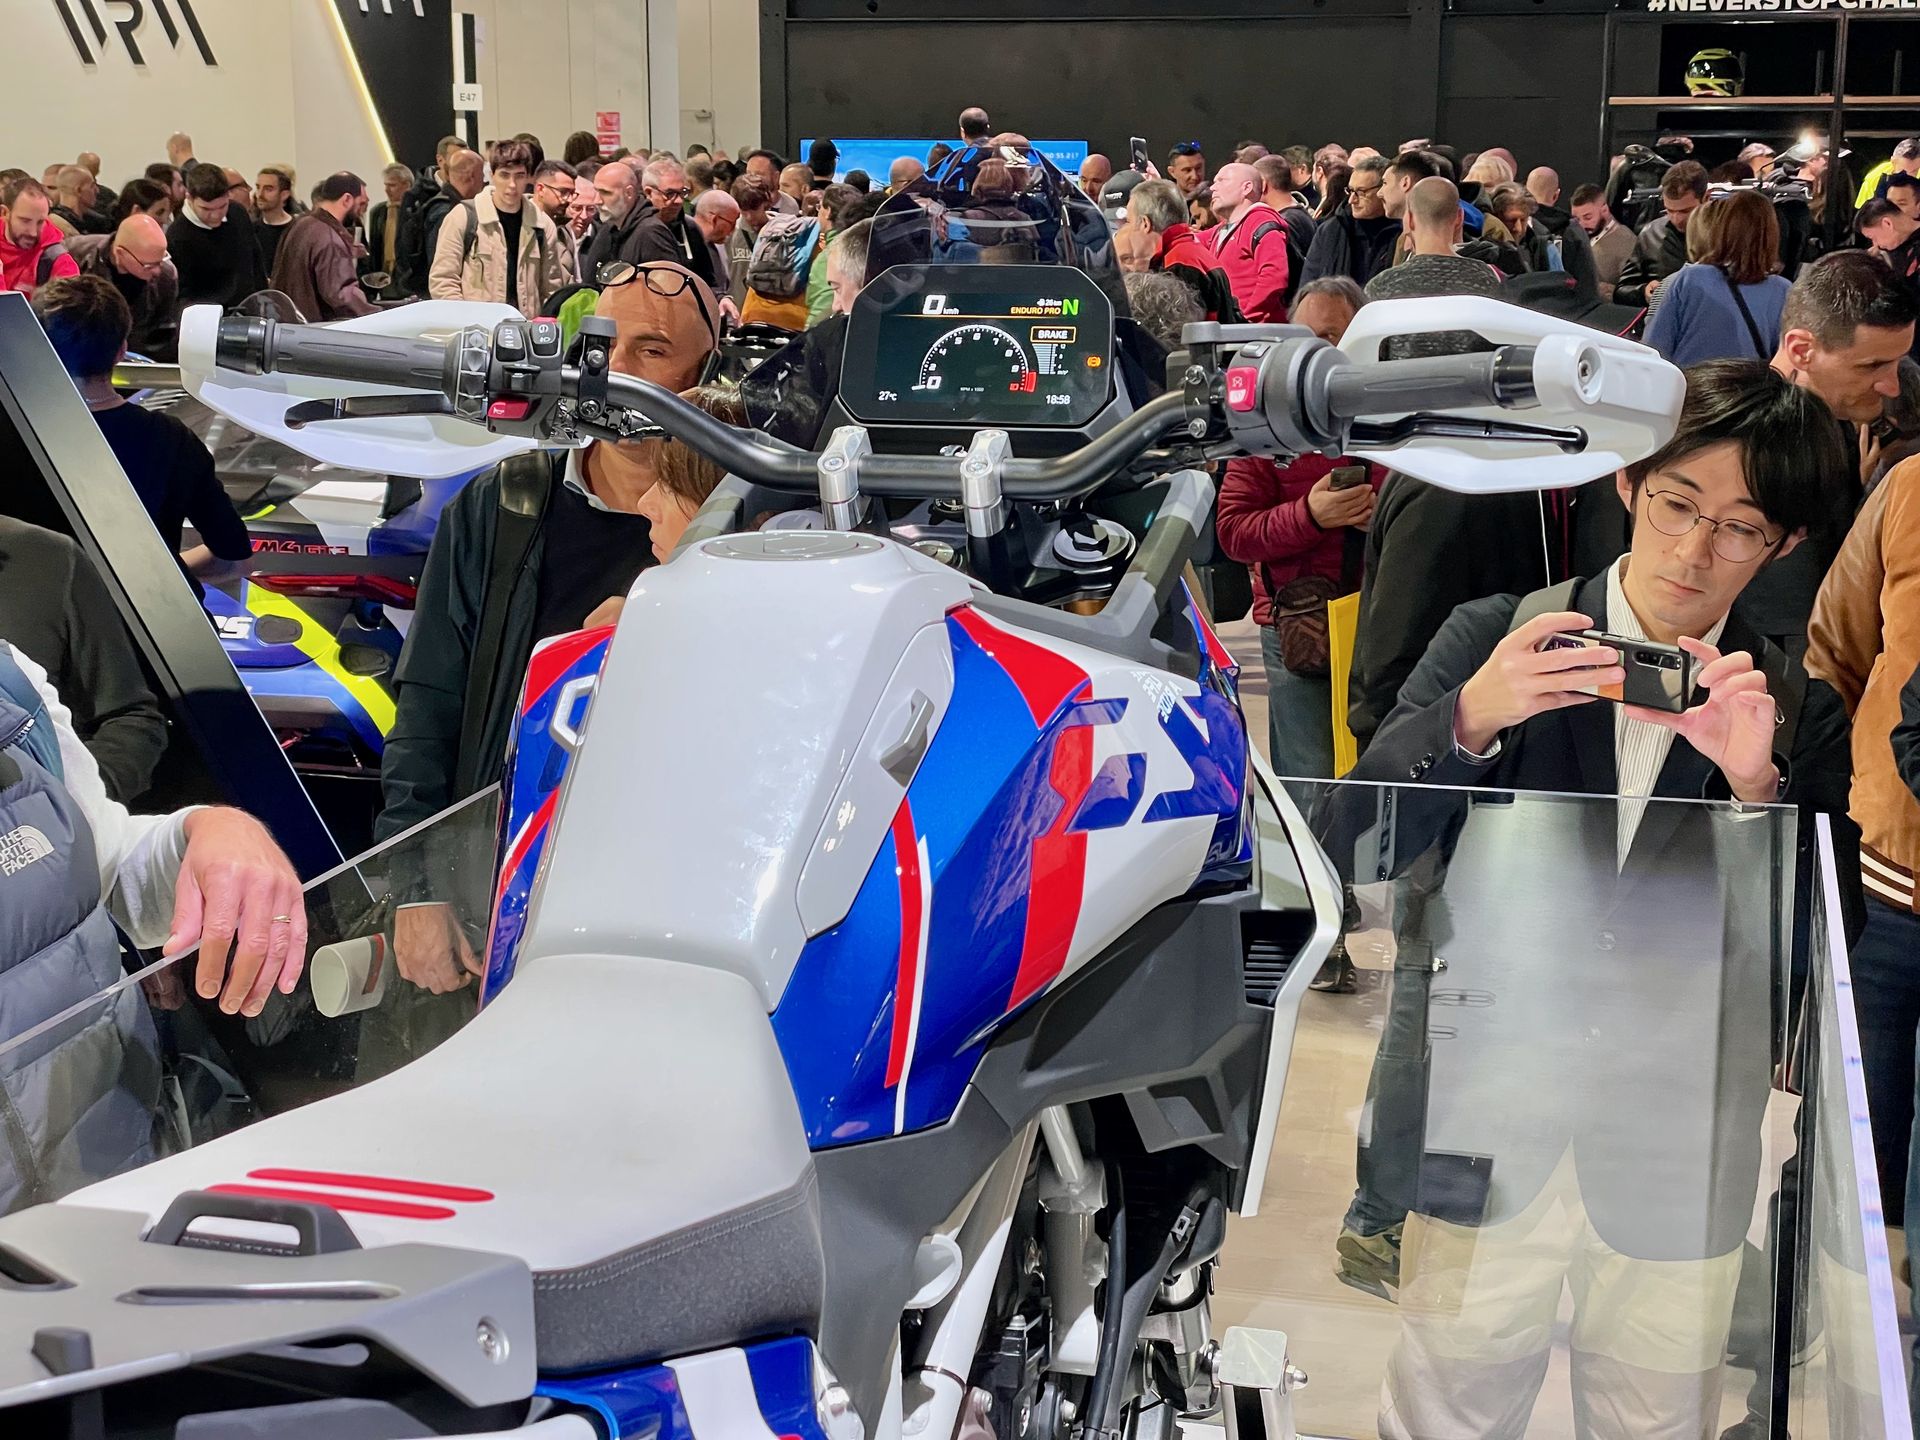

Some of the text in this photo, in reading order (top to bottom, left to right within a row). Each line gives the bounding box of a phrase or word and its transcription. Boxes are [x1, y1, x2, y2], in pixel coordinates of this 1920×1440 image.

[1647, 0, 1920, 12] #NEVERSTOPCHAL
[459, 93, 477, 102] E47
[922, 294, 946, 315] 0
[1062, 299, 1079, 316] N
[1010, 307, 1061, 315] ENDURO PRO
[1038, 330, 1068, 339] BRAKE
[926, 376, 942, 389] 0
[1045, 394, 1071, 405] 18:58
[0, 829, 22, 850] THE
[2, 850, 36, 877] FACE
